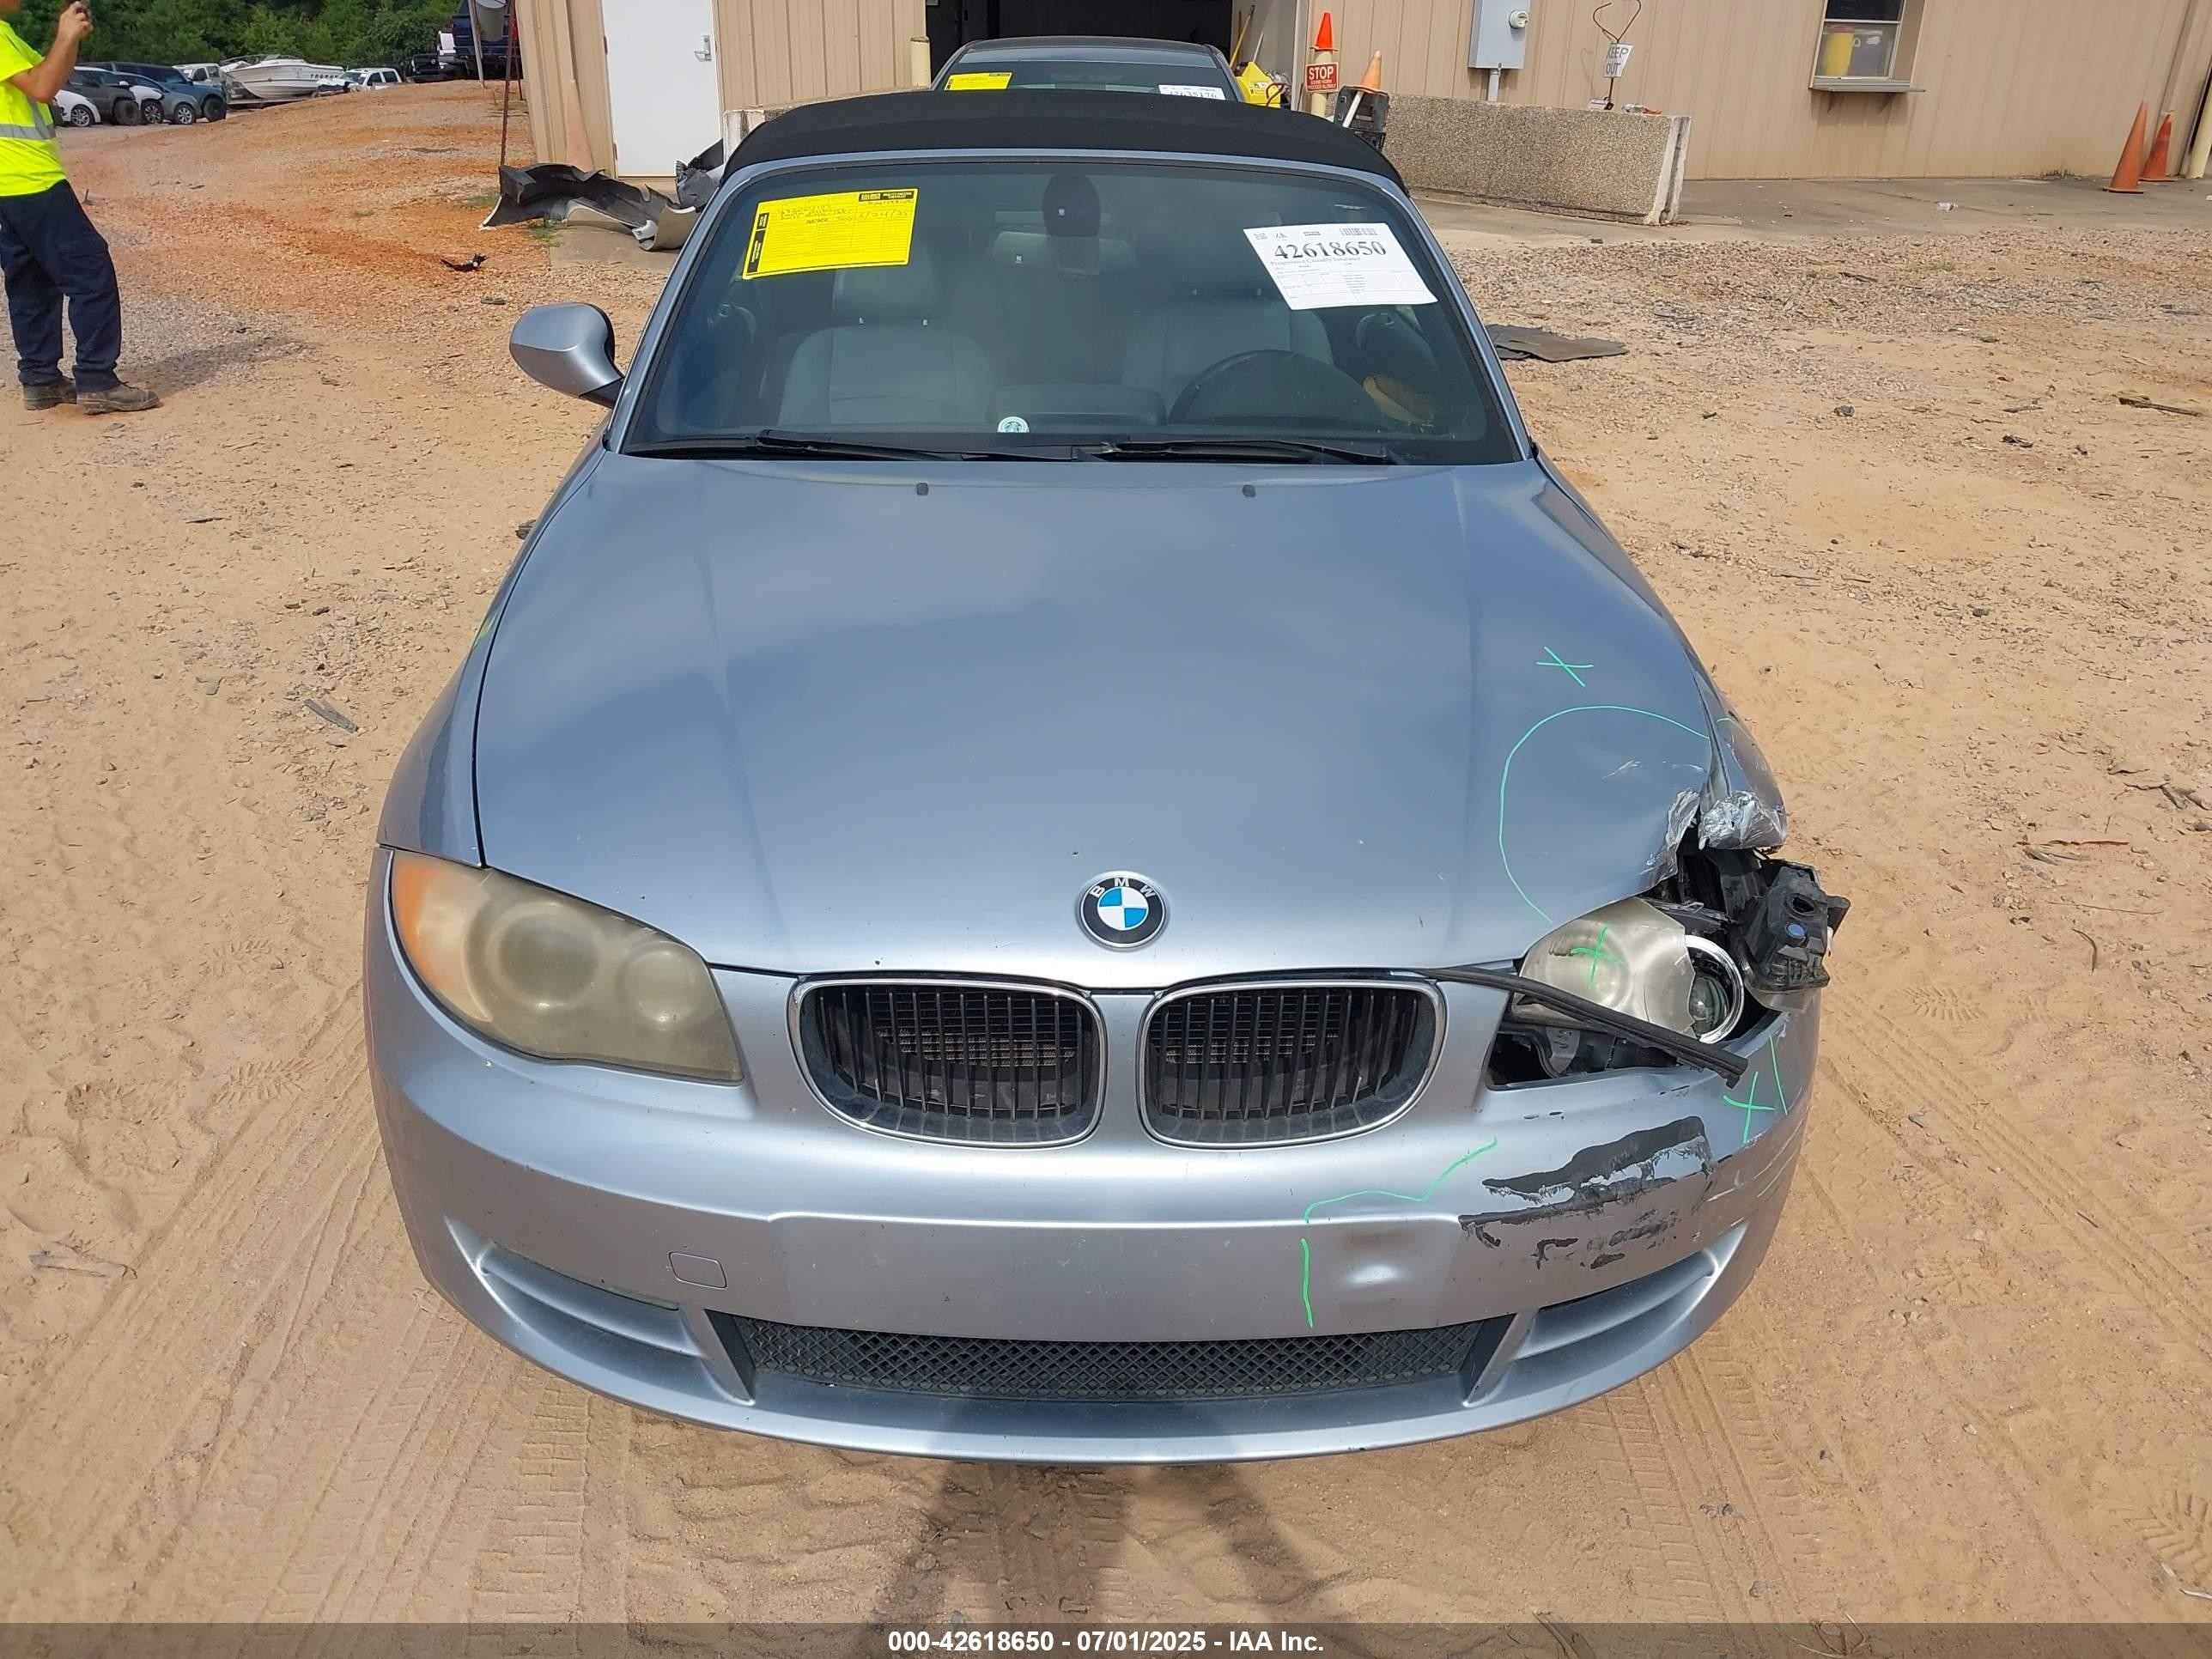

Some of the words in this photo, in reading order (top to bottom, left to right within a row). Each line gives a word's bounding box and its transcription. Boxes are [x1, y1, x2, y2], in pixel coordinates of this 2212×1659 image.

[1606, 46, 1629, 59] KEEP
[1309, 65, 1334, 80] STOP
[1606, 62, 1621, 75] OUT
[1274, 240, 1387, 259] 42618650
[1089, 877, 1157, 898] BMW
